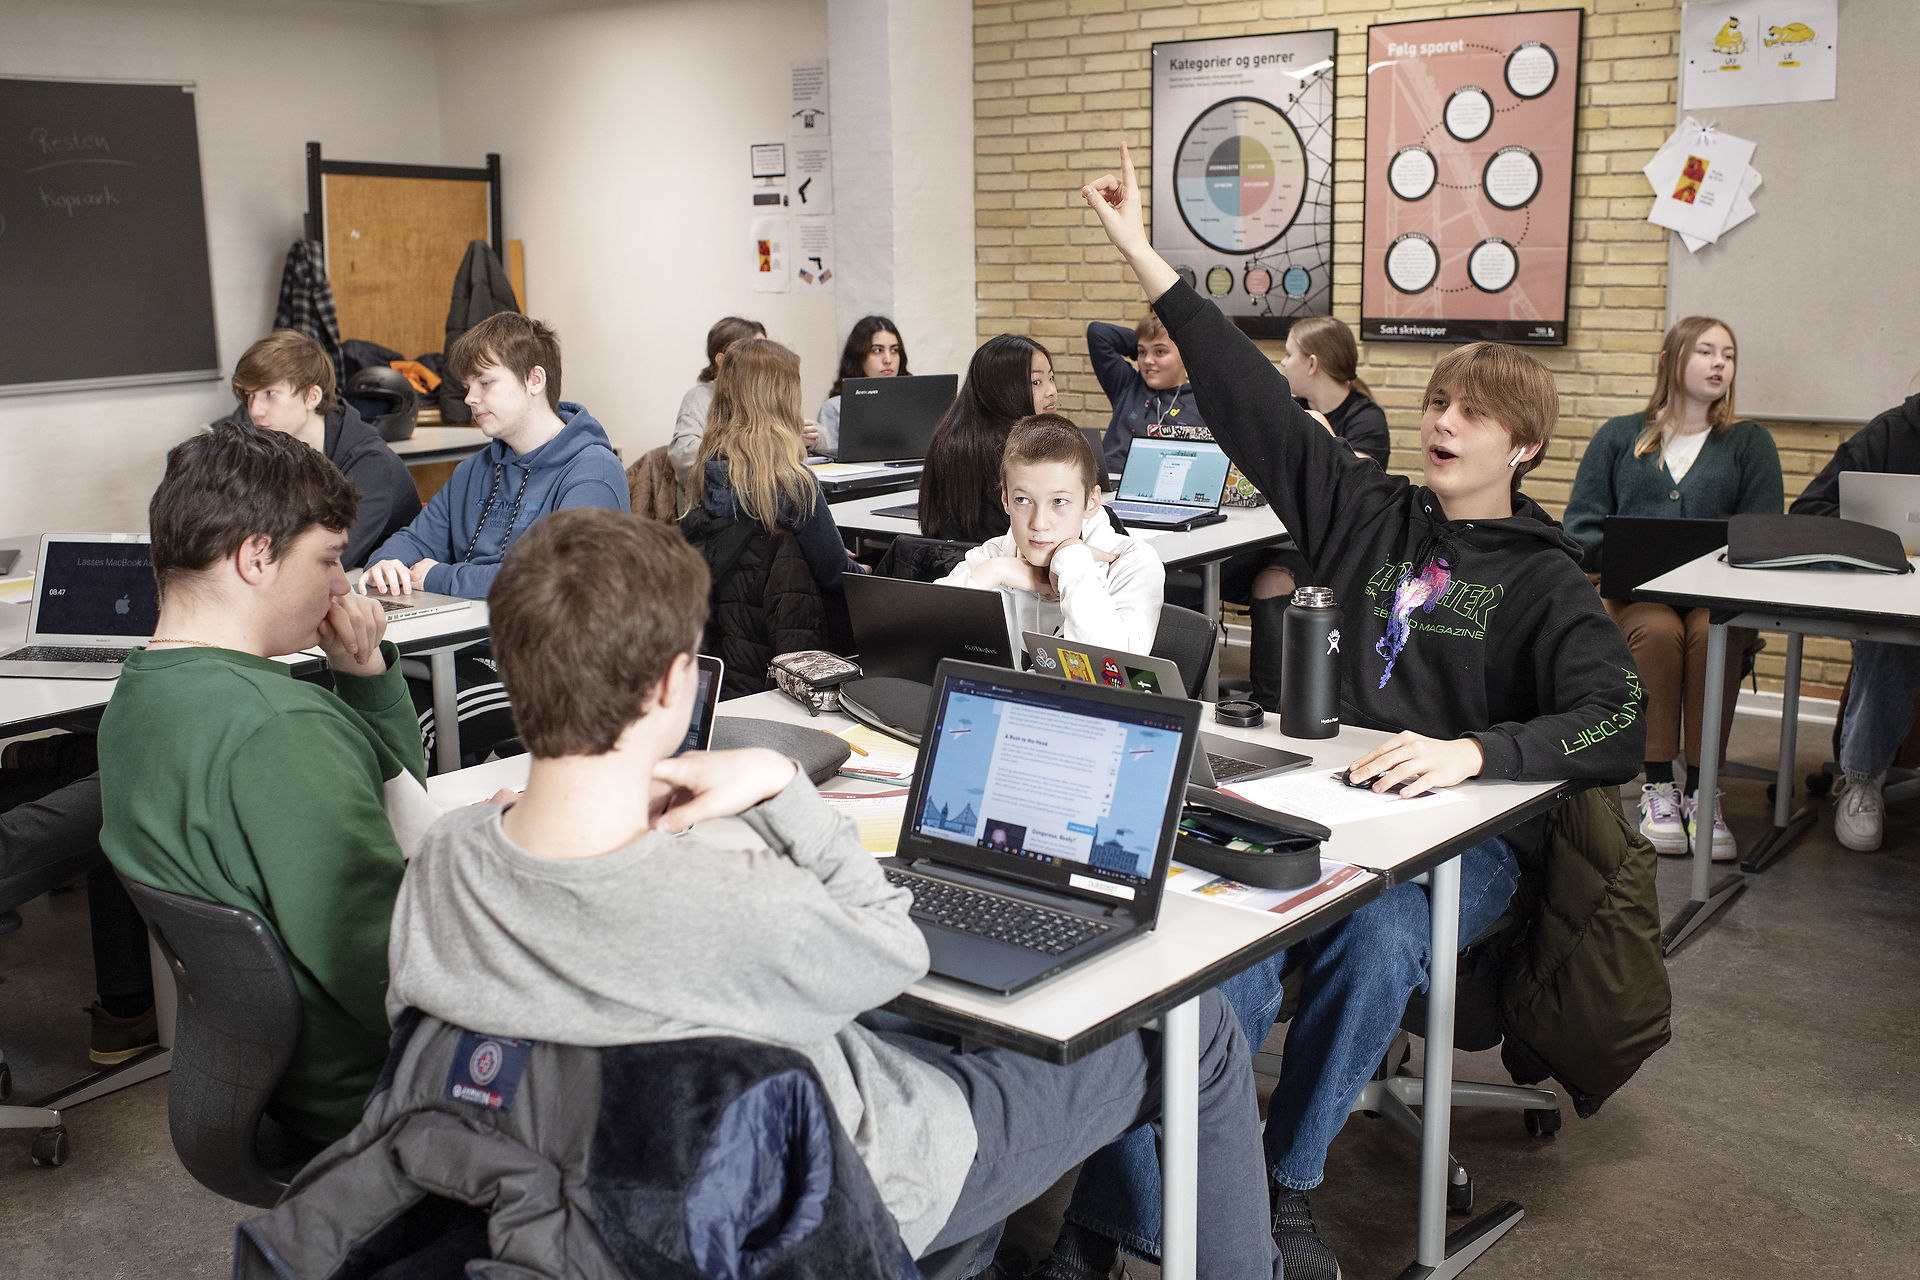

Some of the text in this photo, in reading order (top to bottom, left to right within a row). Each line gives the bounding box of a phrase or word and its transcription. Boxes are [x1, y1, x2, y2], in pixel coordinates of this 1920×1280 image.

[1419, 39, 1465, 56] sporet
[1169, 52, 1295, 72] Kategorier og genrer
[1399, 325, 1448, 338] skrivespor
[77, 557, 153, 568] Lasses MacBook Ai
[1367, 553, 1504, 632] HRASHER
[1418, 622, 1485, 641] MAGAZINE
[1560, 720, 1619, 756] DRIFT
